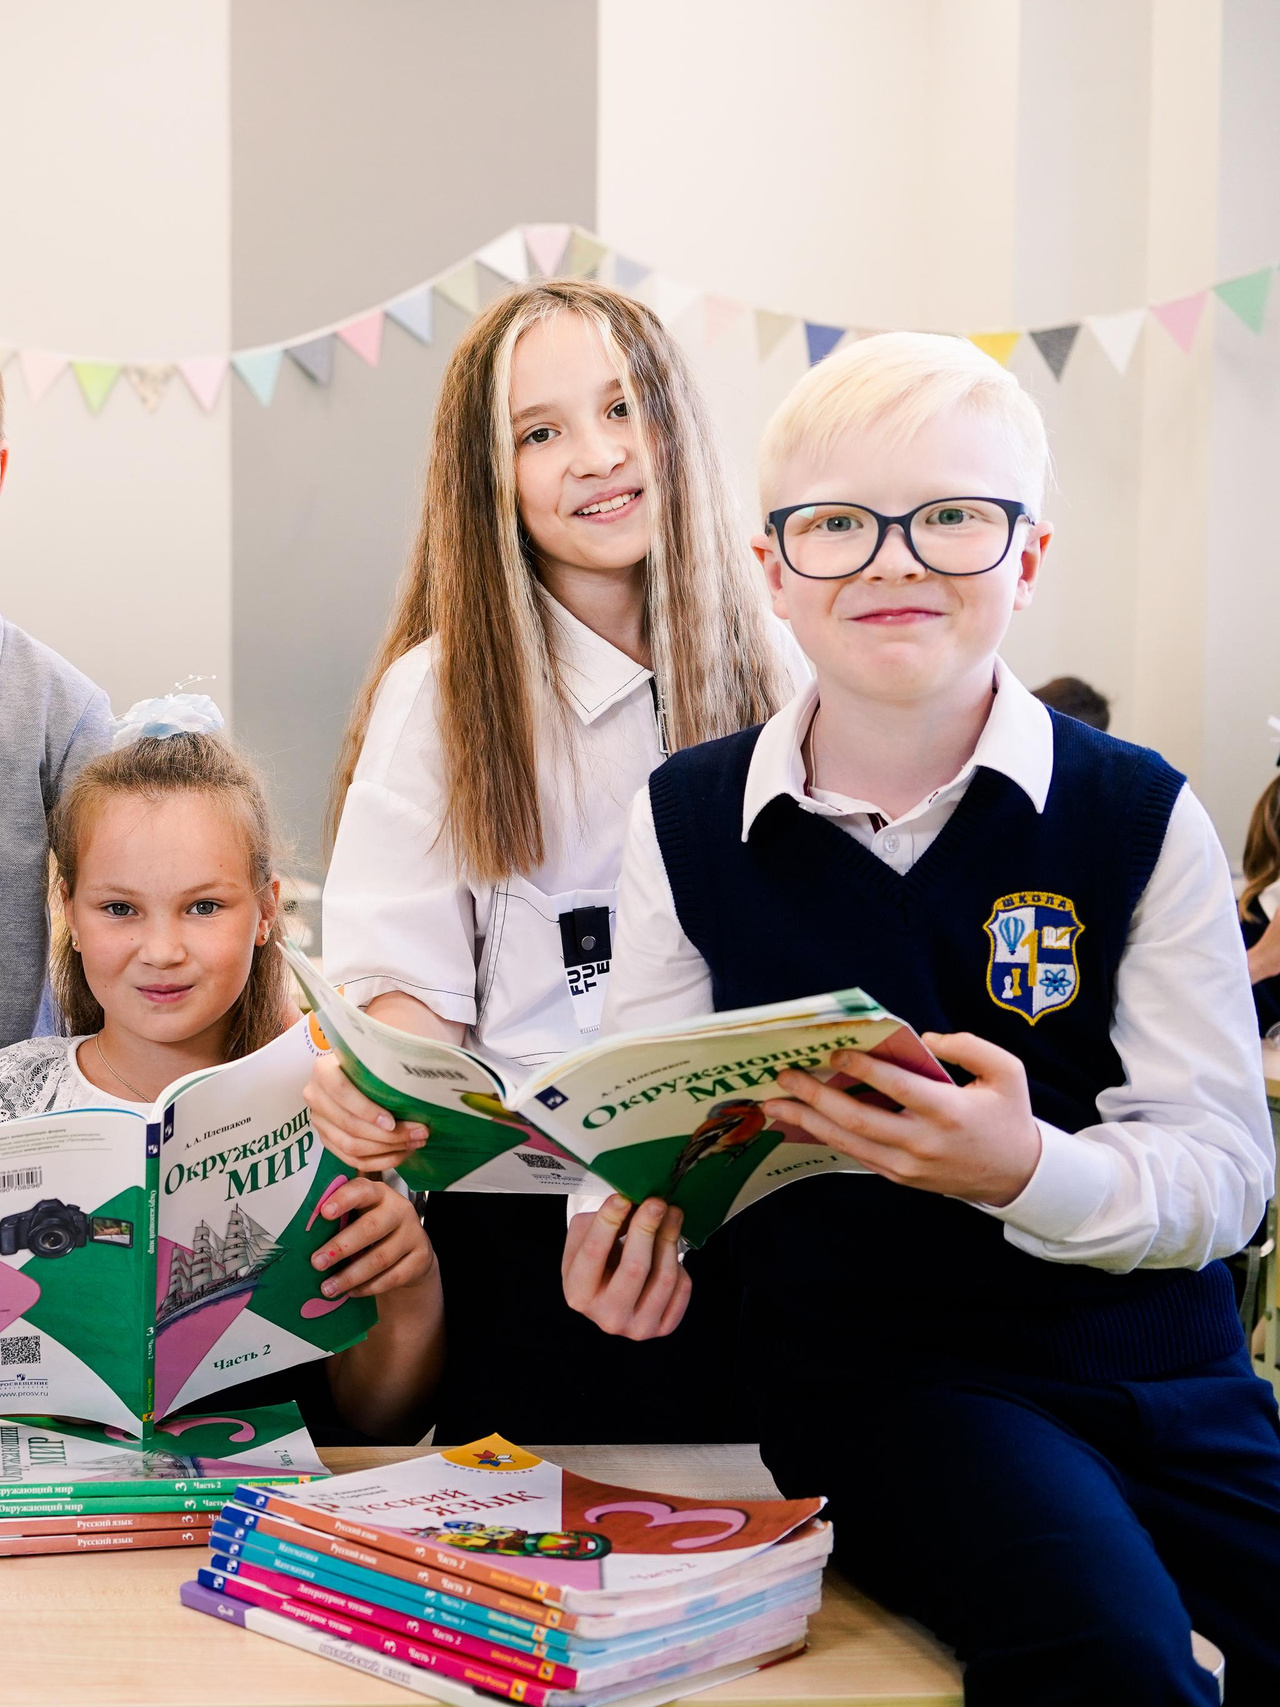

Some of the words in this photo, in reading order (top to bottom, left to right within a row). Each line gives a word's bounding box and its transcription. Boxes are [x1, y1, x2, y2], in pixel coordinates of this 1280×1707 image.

[1002, 895, 1067, 909] ШКОЛА
[583, 1036, 859, 1129] Окружающий
[203, 1115, 253, 1142] Плешаков
[164, 1107, 312, 1195] Окружающ
[224, 1130, 314, 1202] МИР
[766, 1159, 823, 1177] Часть
[149, 1189, 158, 1241] Окружающий
[146, 1327, 154, 1337] 3
[213, 1349, 259, 1371] Часть
[262, 1344, 272, 1356] 2
[28, 1436, 68, 1467] МИР
[444, 1462, 482, 1474] ШКОЛА
[54, 1486, 74, 1496] мир
[174, 1481, 188, 1492] 3
[193, 1481, 215, 1490] Часть
[216, 1481, 222, 1489] 2
[423, 1490, 548, 1517] ЯЗЫК
[64, 1503, 84, 1514] мир
[184, 1500, 197, 1509] 3
[202, 1499, 224, 1507] Часть
[76, 1519, 114, 1529] Русский
[115, 1518, 134, 1526] язык
[181, 1514, 194, 1524] 3
[76, 1537, 114, 1547] Русский
[115, 1536, 134, 1545] язык
[181, 1532, 195, 1542] 3
[584, 1500, 750, 1549] 3
[334, 1520, 361, 1536] Русский
[360, 1528, 379, 1541] язык
[414, 1547, 426, 1558] 3
[437, 1552, 458, 1567] Часть
[459, 1560, 467, 1570] 2
[278, 1542, 319, 1563] Математика
[425, 1590, 437, 1603] 3
[330, 1542, 359, 1559] Русский
[359, 1553, 378, 1565] язык
[417, 1571, 429, 1583] 3
[441, 1577, 464, 1593] Часть
[466, 1585, 472, 1596] 1
[273, 1558, 315, 1580] Математика
[424, 1606, 436, 1619] 3
[297, 1583, 346, 1607] Литературное
[347, 1600, 374, 1616] чтение
[406, 1620, 419, 1633] 3
[432, 1627, 454, 1643] Часть
[454, 1635, 462, 1645] 2
[280, 1601, 327, 1625] Литературное
[328, 1619, 353, 1635] чтение
[383, 1640, 397, 1653] 3
[408, 1647, 430, 1663] Часть
[430, 1655, 437, 1666] 1
